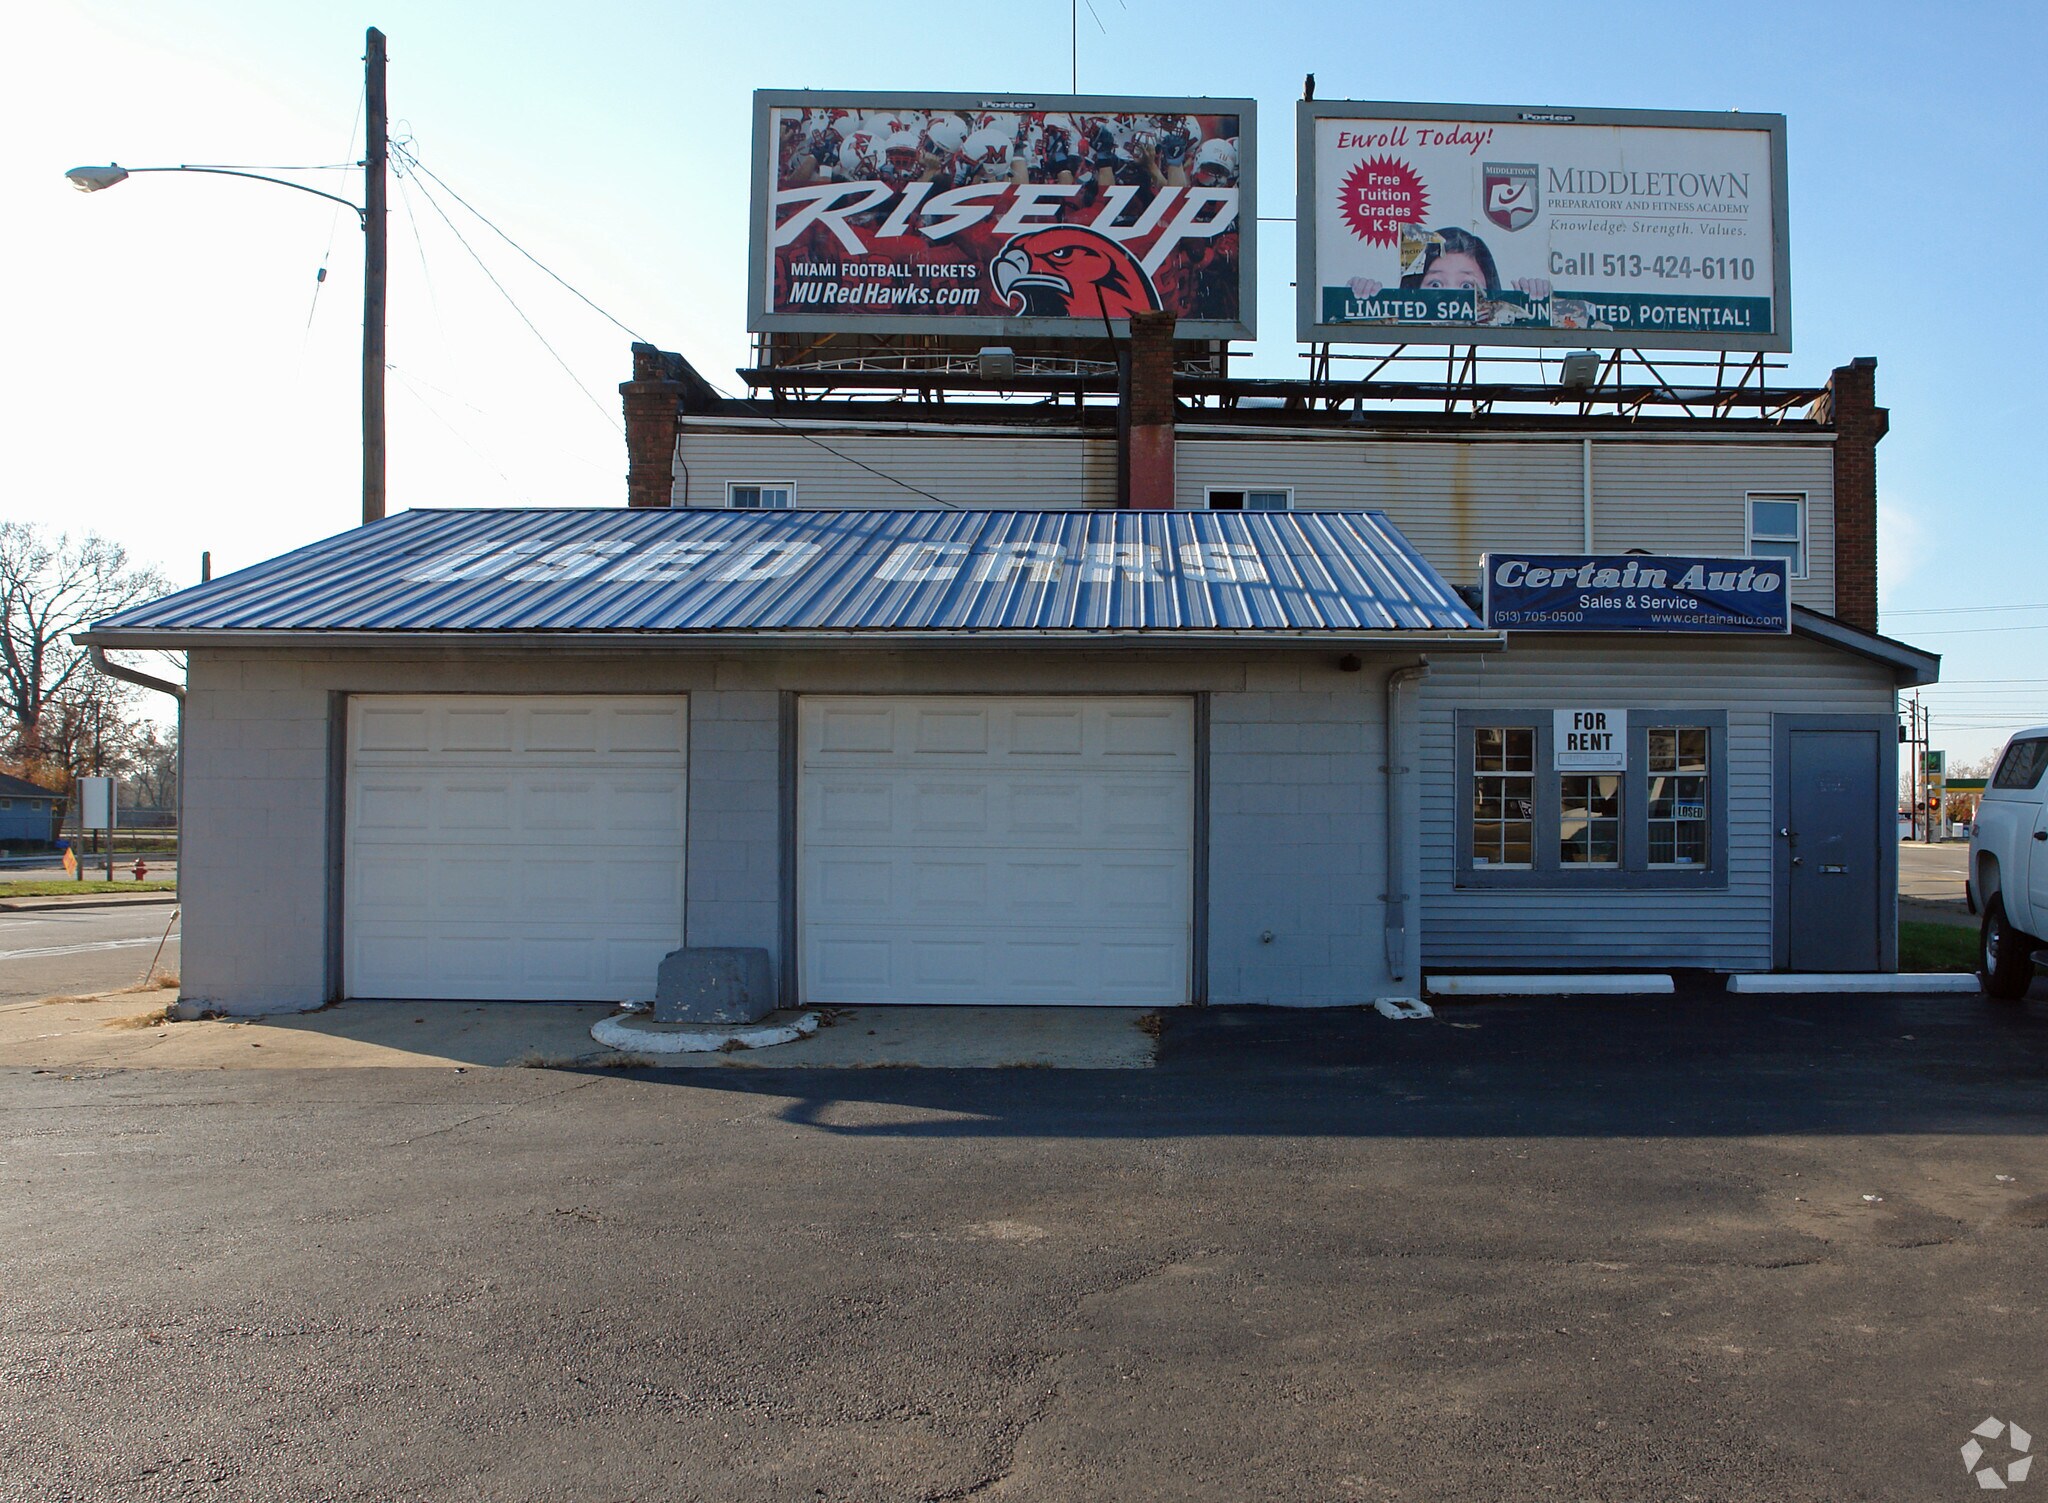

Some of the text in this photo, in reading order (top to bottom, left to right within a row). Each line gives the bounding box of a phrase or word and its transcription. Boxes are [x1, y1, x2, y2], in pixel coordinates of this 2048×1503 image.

[1337, 124, 1494, 156] Enroll Today!
[1368, 172, 1401, 186] Free
[1486, 166, 1536, 176] MIDDLETOWN
[1547, 167, 1750, 199] MIDDLETOWN
[1358, 188, 1411, 202] Tuition
[1358, 203, 1411, 217] Grades
[1548, 199, 1750, 214] PREPARATORY AND FITNESS ACADEMY
[775, 180, 1240, 278] RISE UP
[1373, 219, 1398, 232] K-8
[1550, 219, 1747, 238] Knowledge. Strength. Values.
[791, 262, 977, 279] MIAMI FOOTBALL TICKETS
[1549, 251, 1755, 281] Call 513-424-6110
[1344, 300, 1428, 319] LIMITED
[1639, 305, 1751, 327] POTENTIAL!
[403, 539, 1268, 584] USED CARS
[1495, 560, 1781, 593] Certain Auto
[1579, 594, 1698, 610] Sales & Service
[1494, 611, 1783, 626] (513) 705-0500 www.certainauto.com
[1574, 712, 1606, 730] FOR
[1567, 733, 1613, 751] RENT
[1672, 805, 1703, 818] LOSED
